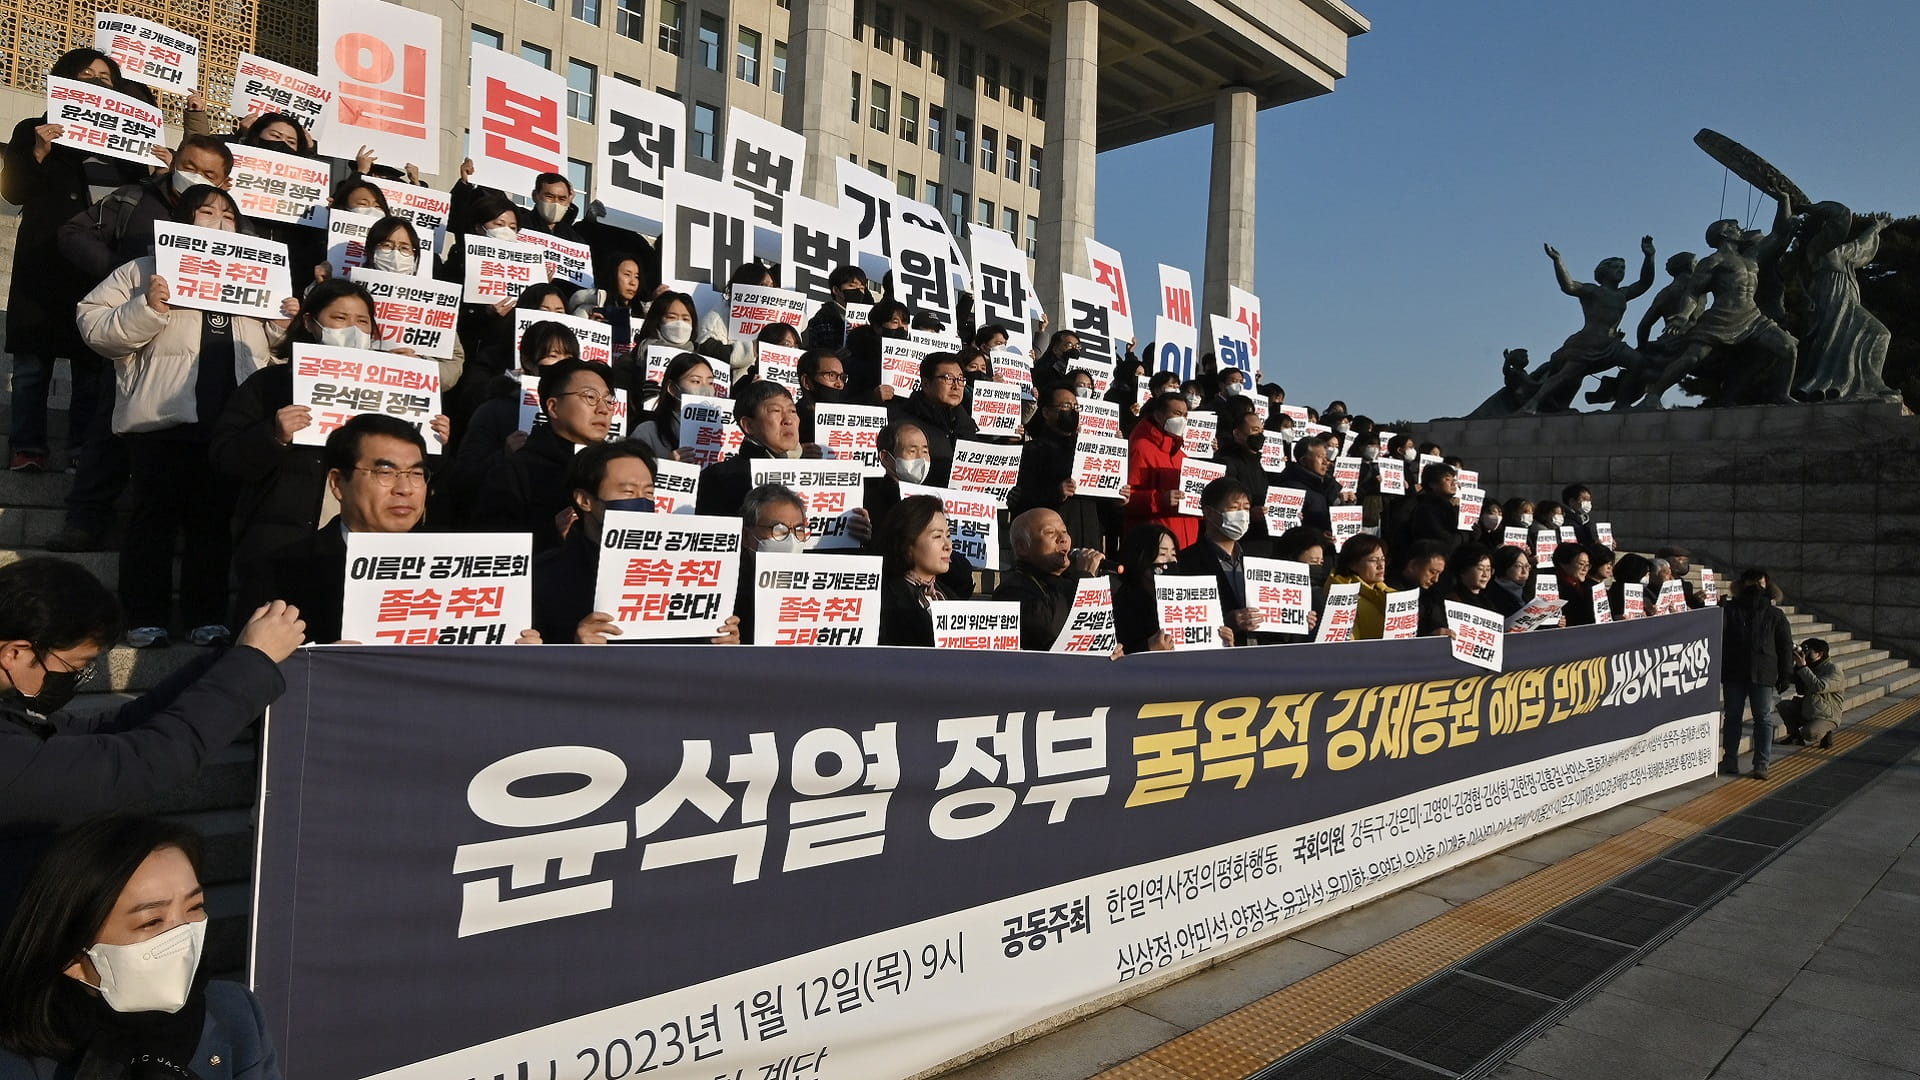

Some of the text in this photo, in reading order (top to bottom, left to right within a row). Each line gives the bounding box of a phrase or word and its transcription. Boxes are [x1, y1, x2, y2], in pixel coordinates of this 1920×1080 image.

[97, 19, 197, 57] 이름만 공개토론회
[111, 34, 181, 67] 졸속 추진
[240, 61, 332, 103] 굴욕적 외교참사
[334, 32, 427, 140] 일
[50, 85, 164, 129] 굴욕적 외교참사
[244, 79, 323, 116] 윤석열 정부
[60, 104, 157, 140] 윤석열 정부
[481, 75, 560, 174] 본
[67, 123, 152, 158] 규탄한다!
[608, 108, 675, 195] 전
[274, 162, 329, 186] 외교참사
[235, 173, 321, 202] 윤석열 정부
[240, 192, 314, 221] 규탄한다!
[404, 192, 450, 215] 외교참사
[416, 211, 442, 230] 정부
[158, 233, 286, 268] 이름만 공개토론회
[467, 243, 543, 265] 이름만 공개토론회
[550, 241, 591, 261] 외교참사
[675, 204, 745, 294] 대
[178, 253, 268, 286] 졸속 추진
[480, 260, 530, 282] 졸속 추진
[562, 255, 586, 270] 정부
[176, 277, 271, 309] 규탄한다!
[371, 282, 459, 309] 2의 합의
[733, 291, 805, 312] 제 2의 합의
[980, 262, 1027, 334] 판
[730, 304, 802, 326] 강제동원 해법
[1164, 285, 1193, 327] 배
[424, 309, 456, 330] 해법
[590, 330, 611, 347] 합의
[1071, 298, 1113, 365] 결
[649, 356, 661, 368] 제
[760, 349, 793, 368] 굴욕적
[883, 345, 909, 358] 제 2의
[298, 355, 440, 394] 굴욕적 외교참사
[310, 382, 431, 416] 윤석열 정부
[973, 399, 1006, 414] 강제동원
[683, 406, 720, 424] 이름만
[817, 413, 888, 429] 이름만 공개토론회
[978, 415, 1016, 429] 폐기하라!
[828, 430, 880, 449] 졸속 추진
[956, 450, 985, 465] 제 2의
[1082, 455, 1120, 473] 졸속 추진
[798, 471, 862, 488] 공개토론회
[951, 465, 1018, 485] 강제동원 해법
[1078, 472, 1121, 490] 규탄한다!
[811, 491, 846, 513] 추진
[944, 499, 997, 520] 외교참사
[961, 519, 991, 539] 정부
[604, 528, 740, 554] 이름만 공개토론회
[350, 554, 530, 582] 이름만 공개토론회
[623, 557, 722, 588] 졸속 추진
[1246, 568, 1310, 587] 이름만 공개토론회
[758, 570, 881, 592] 이름만 공개토론회
[376, 585, 505, 623] 졸속 추진
[1174, 586, 1218, 601] 공개토론회
[1258, 585, 1303, 606] 졸속 추진
[617, 593, 722, 622] 규탄한다!
[778, 595, 863, 623] 졸속 추진
[1163, 604, 1208, 623] 졸속 추진
[1447, 608, 1472, 623] 이름만
[936, 614, 1019, 631] 제 2의 합의
[1070, 611, 1107, 632] 윤석열
[1458, 623, 1496, 647] 졸속 추진
[1455, 638, 1496, 663] 규탄한다!
[453, 637, 1712, 938] 윤석열 정부 굴욕적 강제동원 해법 반대 비상시국선언
[1001, 894, 1092, 959] 공동주최
[1292, 823, 1346, 865] 국회의원
[576, 930, 967, 1080] 2023년 1월 12일(목) 9시
